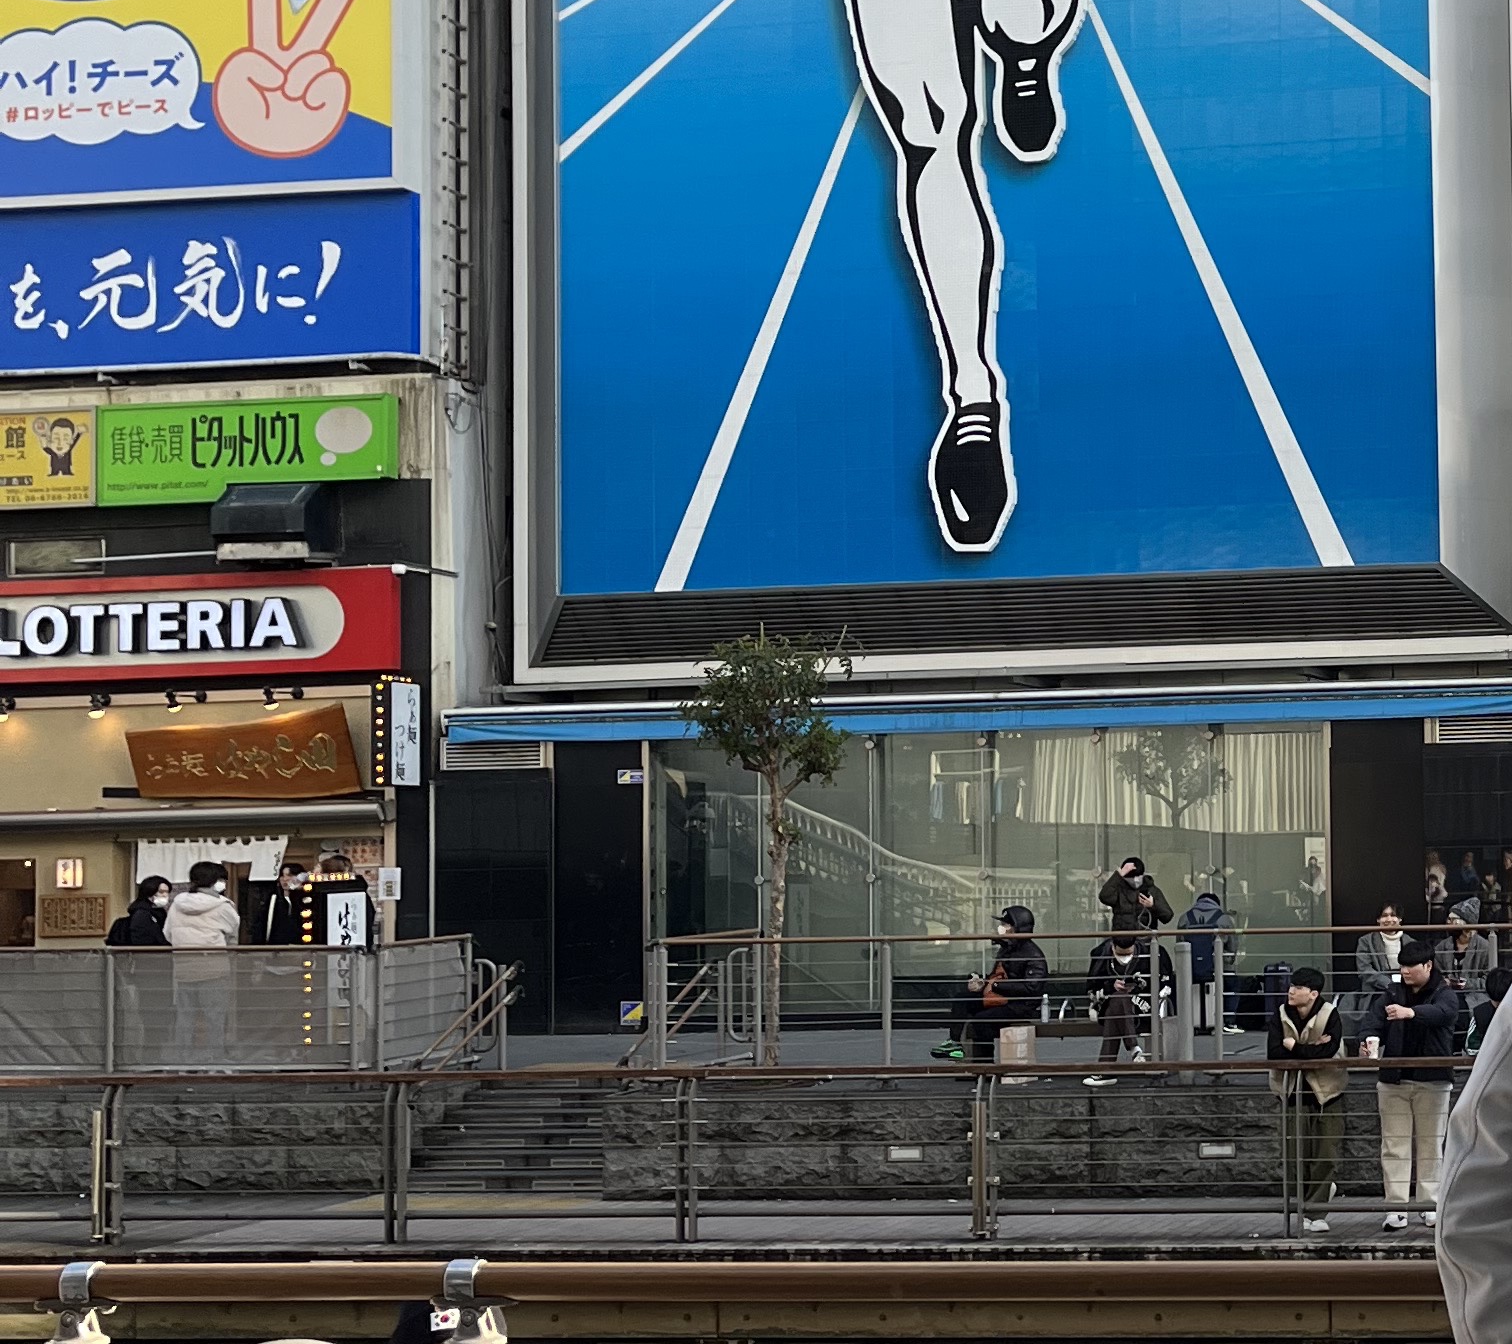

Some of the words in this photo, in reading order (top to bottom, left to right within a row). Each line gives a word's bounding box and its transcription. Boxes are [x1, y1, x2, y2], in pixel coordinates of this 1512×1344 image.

[191, 411, 304, 469] ピタットハウス
